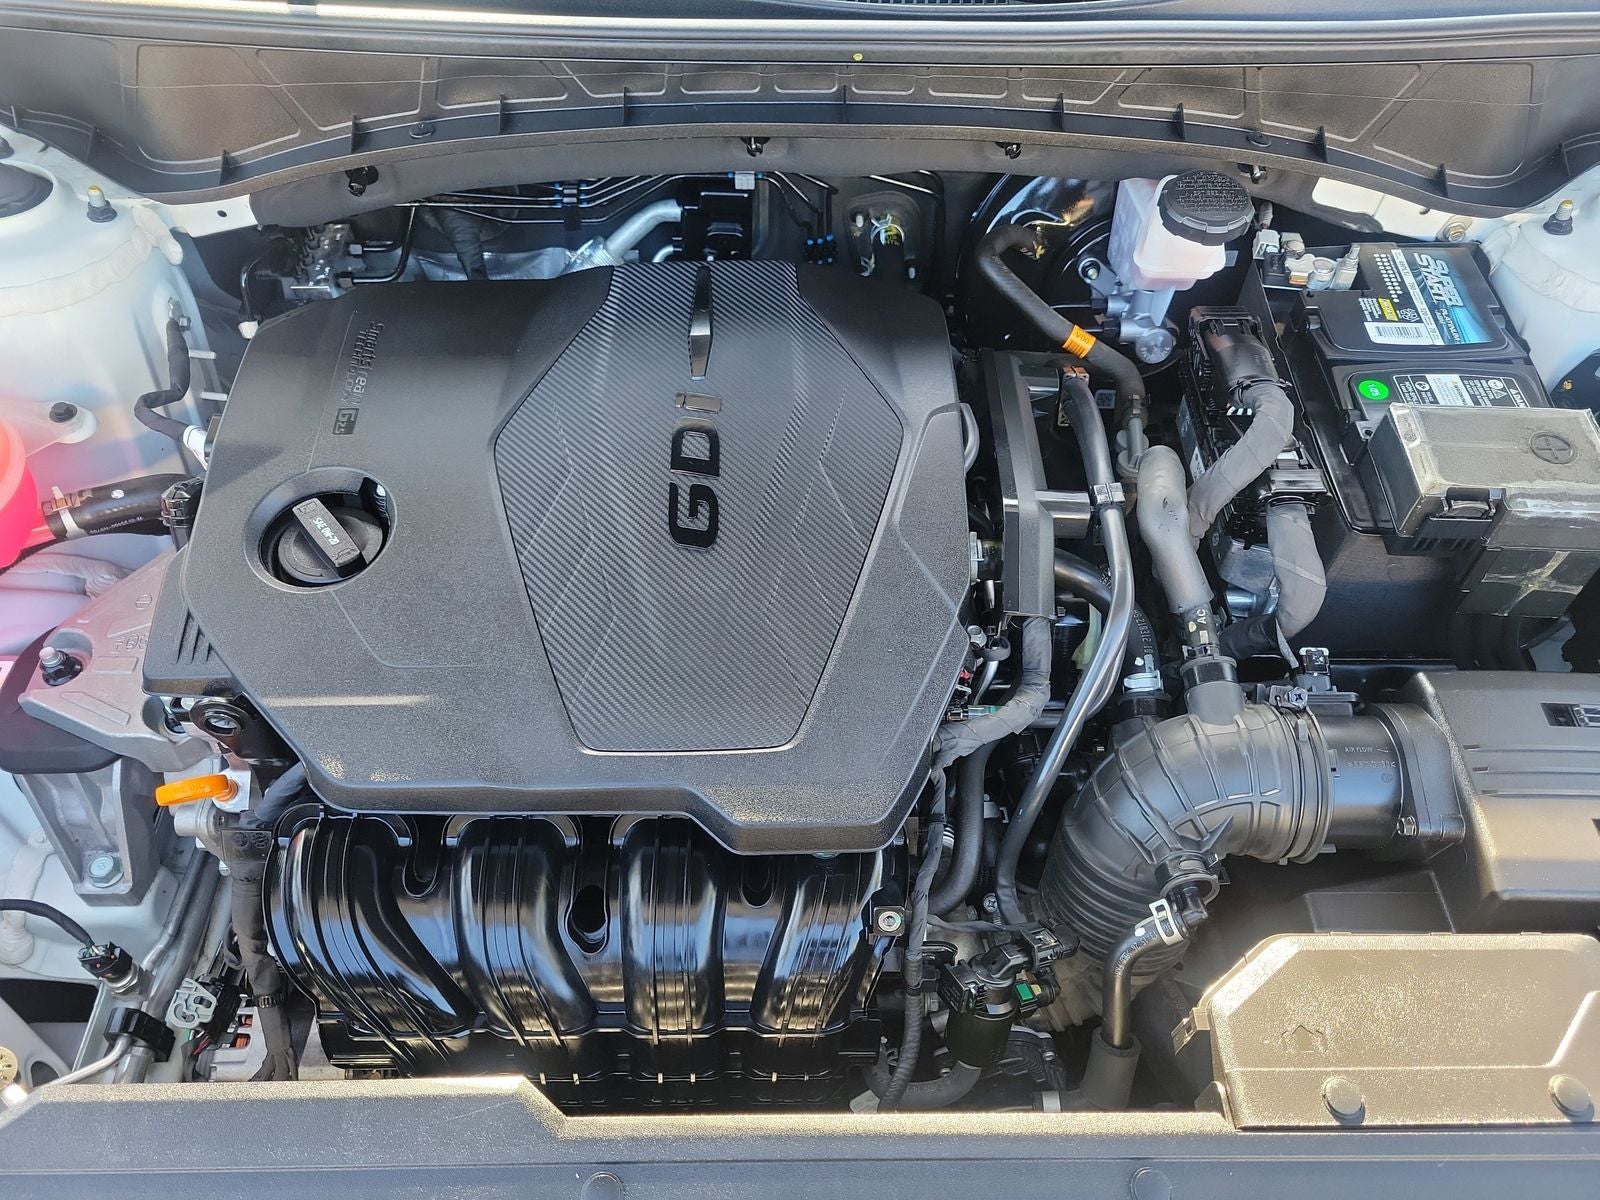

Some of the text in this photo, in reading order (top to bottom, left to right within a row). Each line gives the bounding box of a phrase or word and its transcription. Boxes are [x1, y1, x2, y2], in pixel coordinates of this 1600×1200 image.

[1413, 252, 1448, 303] START
[1434, 258, 1464, 307] SUPER
[340, 329, 369, 405] TECHNOLOGY
[351, 321, 385, 405] Smartstream
[312, 516, 341, 548] SAE 0W-20
[1196, 608, 1207, 625] AC
